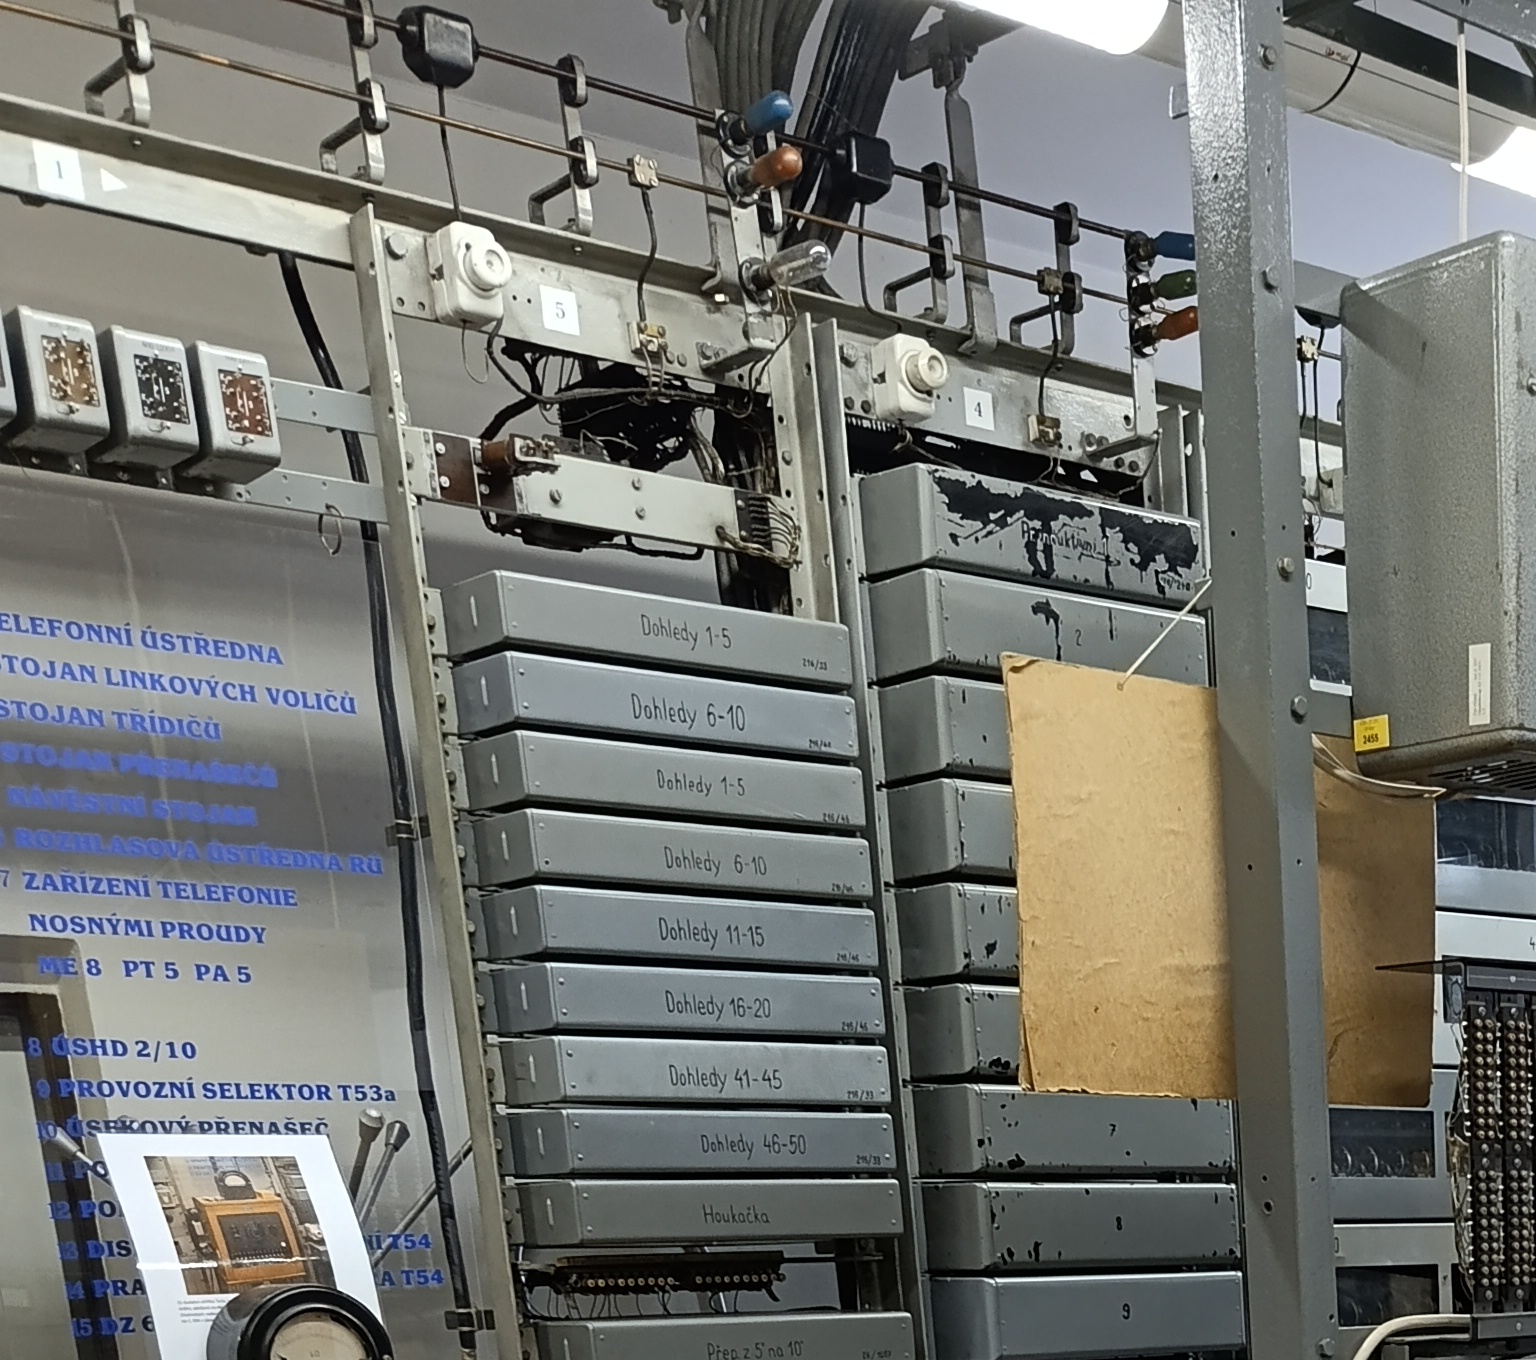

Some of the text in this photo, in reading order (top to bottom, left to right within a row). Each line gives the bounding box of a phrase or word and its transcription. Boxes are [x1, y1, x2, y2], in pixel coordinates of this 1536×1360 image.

[56, 160, 63, 179] 1
[555, 301, 566, 319] 5
[974, 401, 983, 418] 4
[0, 612, 284, 666] ELEFONNÍ ÚSTŘEDNA
[640, 613, 733, 650] Dohledy 1-5
[1075, 629, 1083, 647] 2
[0, 654, 358, 715] TOJAN LINKOVÝCH VOLIČŮ
[0, 699, 222, 741] STOJAN TŘÍDIČŮ
[631, 692, 746, 732] Dohledy 6-10
[656, 768, 747, 797] Dohledy 1-5
[14, 828, 384, 876] ROZHLASOVÁ ÚSTŘEDNA RÚ
[664, 845, 769, 878] Dohledy 6-10
[22, 868, 152, 898] ZAŘÍZENÍ
[156, 880, 299, 907] TELEFONIE
[28, 913, 267, 944] NOSNÝMI PROUDY
[658, 916, 767, 951] Dohledy 11-15
[37, 957, 252, 984] ME 8 PT 5 PA 5
[665, 989, 772, 1022] Dohledy 16-20
[27, 1033, 198, 1062] 8 ÚSHD 2/10
[36, 1076, 397, 1102] 9 PROVOZNÍ SELEKTOR T53a
[668, 1064, 784, 1093] Dohledy 41-45
[36, 1114, 329, 1139] 10 ÚSEKOVÝ PŘENAŠEČ
[1109, 1123, 1116, 1137] 7
[700, 1133, 807, 1160] Dohledy 46-50
[74, 1160, 109, 1180] PO
[48, 1199, 124, 1220] 12 PO
[703, 1203, 770, 1226] Houkačka
[1115, 1215, 1123, 1232] 8
[86, 1239, 132, 1259] DIS
[386, 1233, 432, 1250] T54
[91, 1278, 147, 1298] PRA
[379, 1269, 396, 1287] A
[401, 1268, 445, 1287] T54
[1122, 1302, 1131, 1320] 9
[72, 1317, 93, 1337] 15
[99, 1316, 136, 1336] DZ
[743, 1347, 751, 1359] z
[768, 1346, 784, 1358] na
